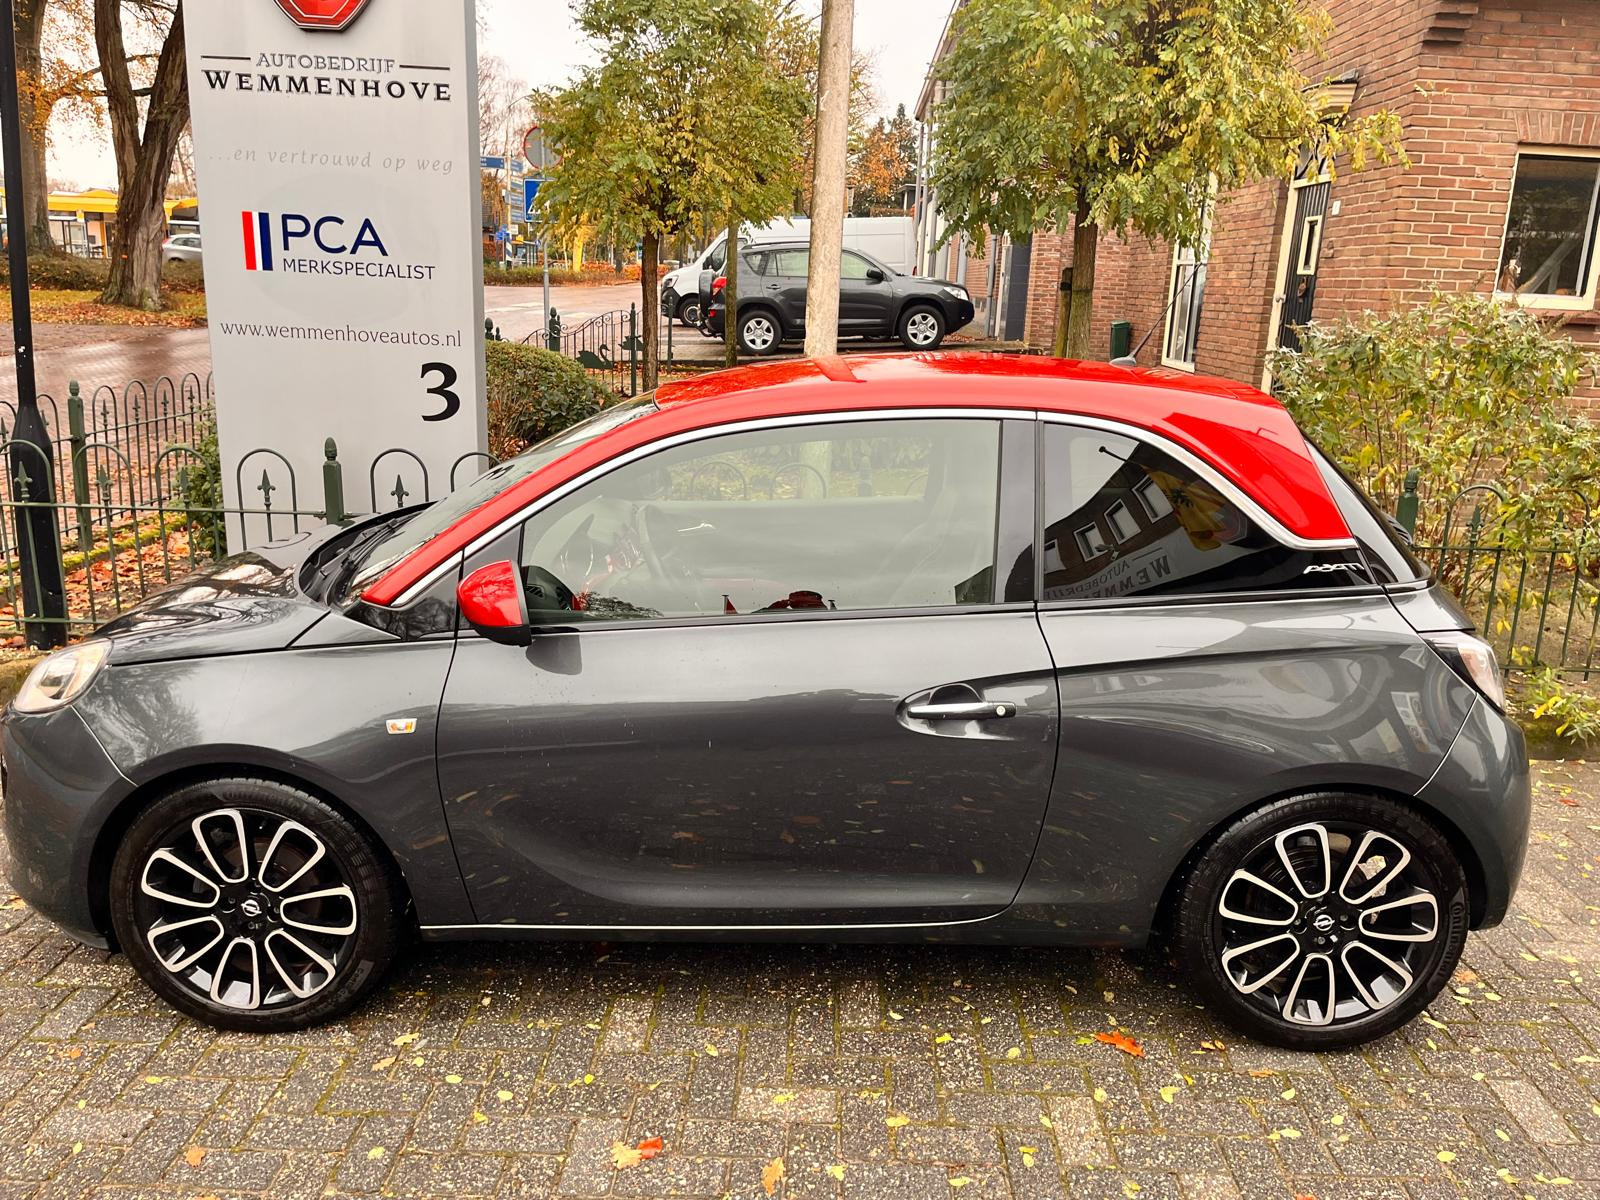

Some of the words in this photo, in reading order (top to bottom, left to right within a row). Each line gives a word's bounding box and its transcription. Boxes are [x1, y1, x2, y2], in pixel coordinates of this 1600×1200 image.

[256, 52, 396, 74] AUTOBEDRIJF
[201, 69, 451, 101] WEMMENHOVE
[268, 149, 372, 168] vertrouwd
[382, 157, 406, 172] op
[416, 160, 453, 174] weg
[281, 213, 389, 256] PCA
[282, 258, 436, 280] MERKSPECIALIST
[220, 321, 462, 347] www.wemmenhoveautos.nl
[419, 361, 461, 422] 3
